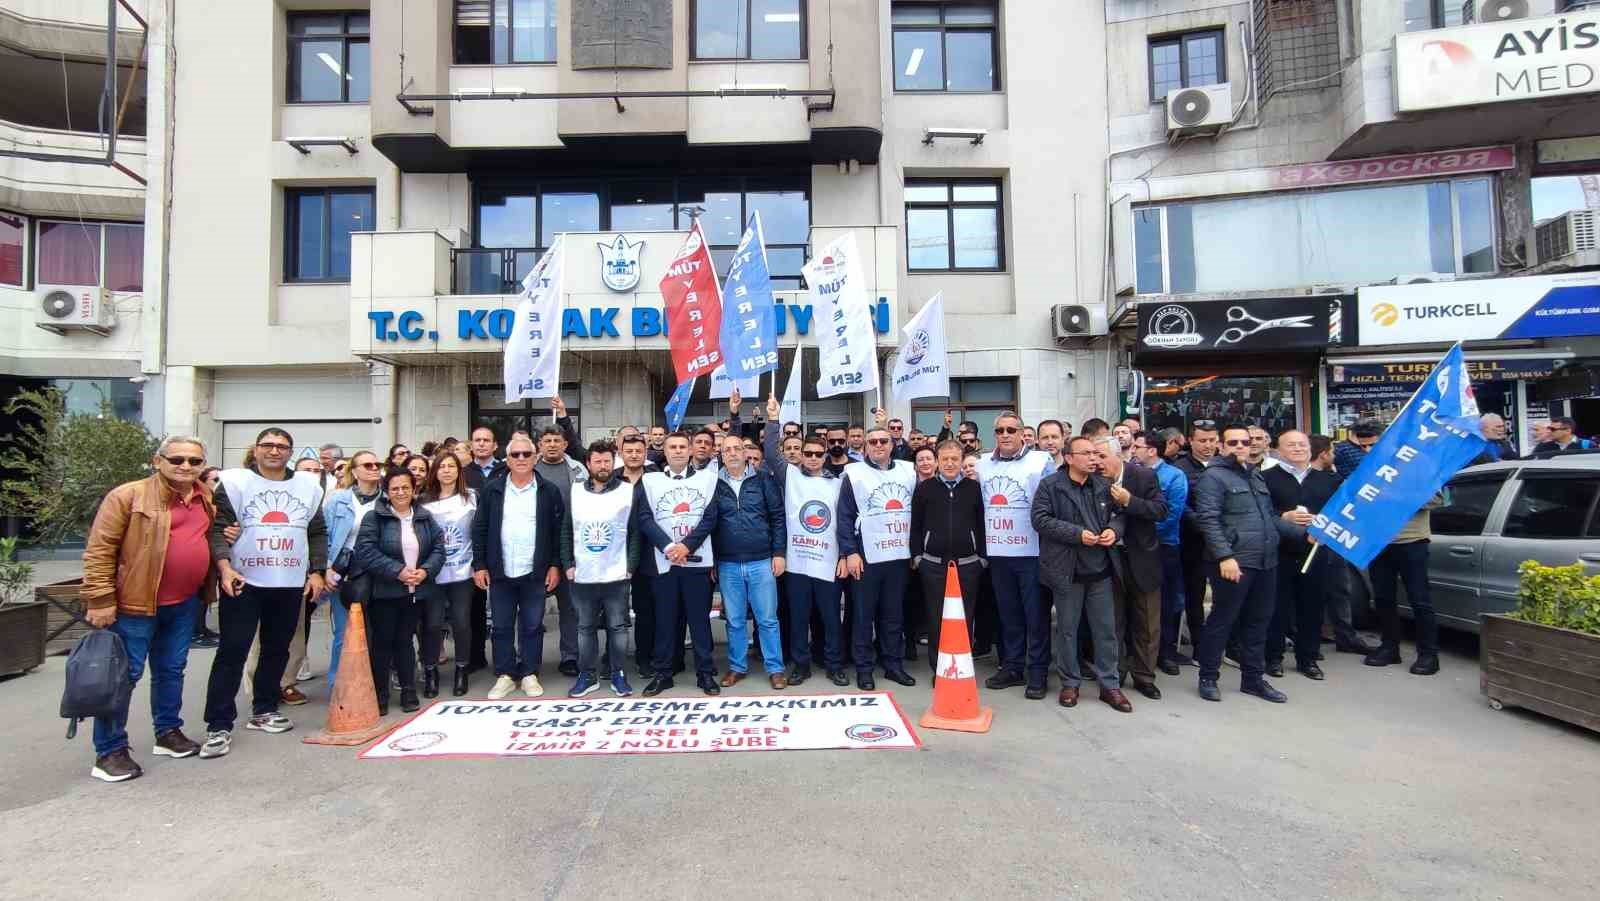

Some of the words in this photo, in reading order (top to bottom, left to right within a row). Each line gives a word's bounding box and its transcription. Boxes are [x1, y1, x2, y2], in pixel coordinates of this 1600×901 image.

[1496, 63, 1594, 96] MED
[1403, 302, 1497, 320] TURKCELL
[368, 310, 440, 342] T.C.
[458, 307, 620, 341] KOAK
[1384, 362, 1505, 373] TURELL
[1311, 513, 1360, 549] SEN
[256, 535, 294, 551] TÜM
[549, 701, 709, 714] SÖZLEŞME
[720, 697, 879, 710] HAKKIMIZ
[512, 716, 602, 728] GASP
[610, 712, 769, 726] EDİLEMEZ
[721, 726, 790, 735] SEN
[506, 738, 586, 750] İZMİR
[620, 738, 699, 749] NOLU
